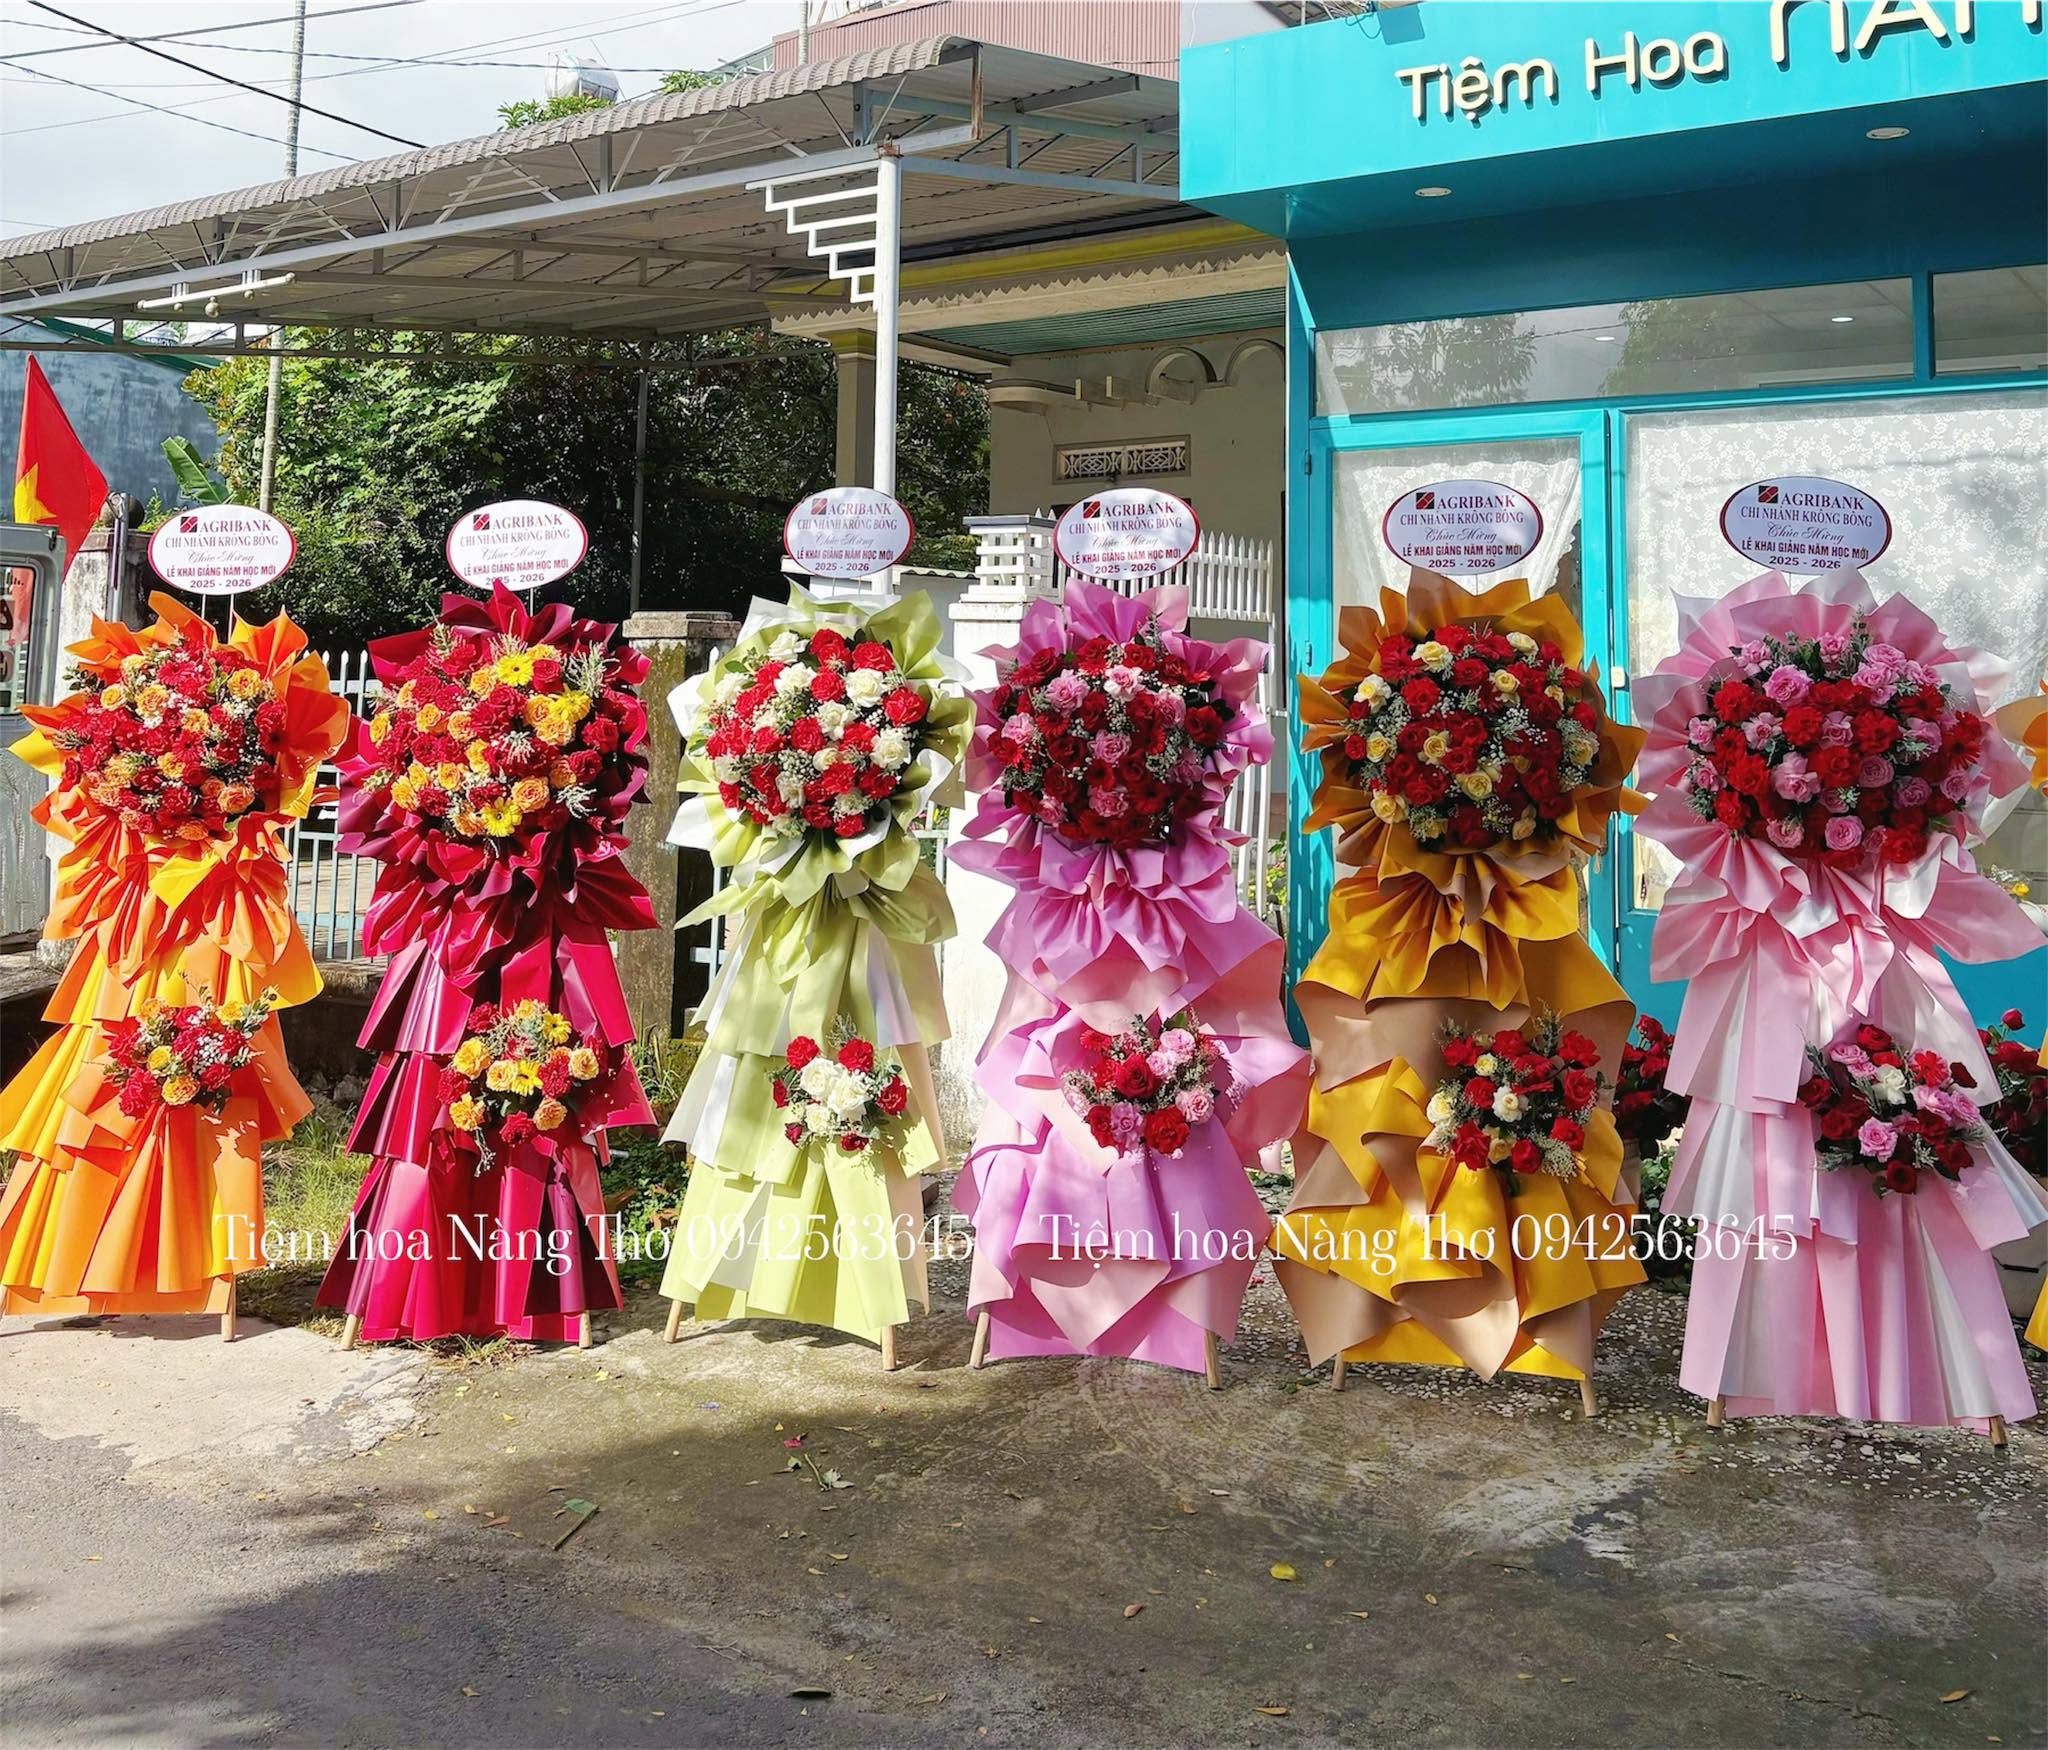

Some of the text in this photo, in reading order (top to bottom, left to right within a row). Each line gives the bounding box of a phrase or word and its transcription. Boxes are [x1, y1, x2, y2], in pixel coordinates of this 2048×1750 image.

[1395, 56, 1558, 122] Tiệm
[1584, 31, 1725, 92] Hoa
[1437, 495, 1515, 509] AGRIBANK
[1782, 493, 1864, 510] AGRIBANK
[828, 503, 891, 515] AGRIBANK
[1104, 502, 1174, 517] AGRIBANK
[1741, 506, 1759, 518] CHI
[493, 514, 563, 530] AGRIBANK
[798, 520, 811, 529] CHI
[1400, 514, 1417, 525] CHI
[200, 520, 271, 532] AGRIBANK
[1069, 524, 1085, 534] CHI
[165, 537, 181, 548] CHI
[460, 535, 475, 547] CHI
[1755, 540, 1776, 551] KHAI
[805, 550, 821, 559] KHAI
[1414, 545, 1433, 556] KHAI
[1082, 554, 1099, 562] KHAI
[1429, 559, 1455, 568] 2025
[1467, 559, 1495, 567] 2026
[1769, 556, 1799, 565] 2025
[1812, 559, 1841, 568] 2026
[178, 567, 195, 577] KHAI
[473, 565, 490, 575] KHAI
[815, 563, 837, 571] 2025
[846, 563, 869, 571] 2026
[1095, 566, 1120, 574] 2025
[1131, 563, 1156, 571] 2026
[190, 580, 215, 588] 2025
[226, 579, 251, 587] 2026
[520, 573, 545, 583] 2026
